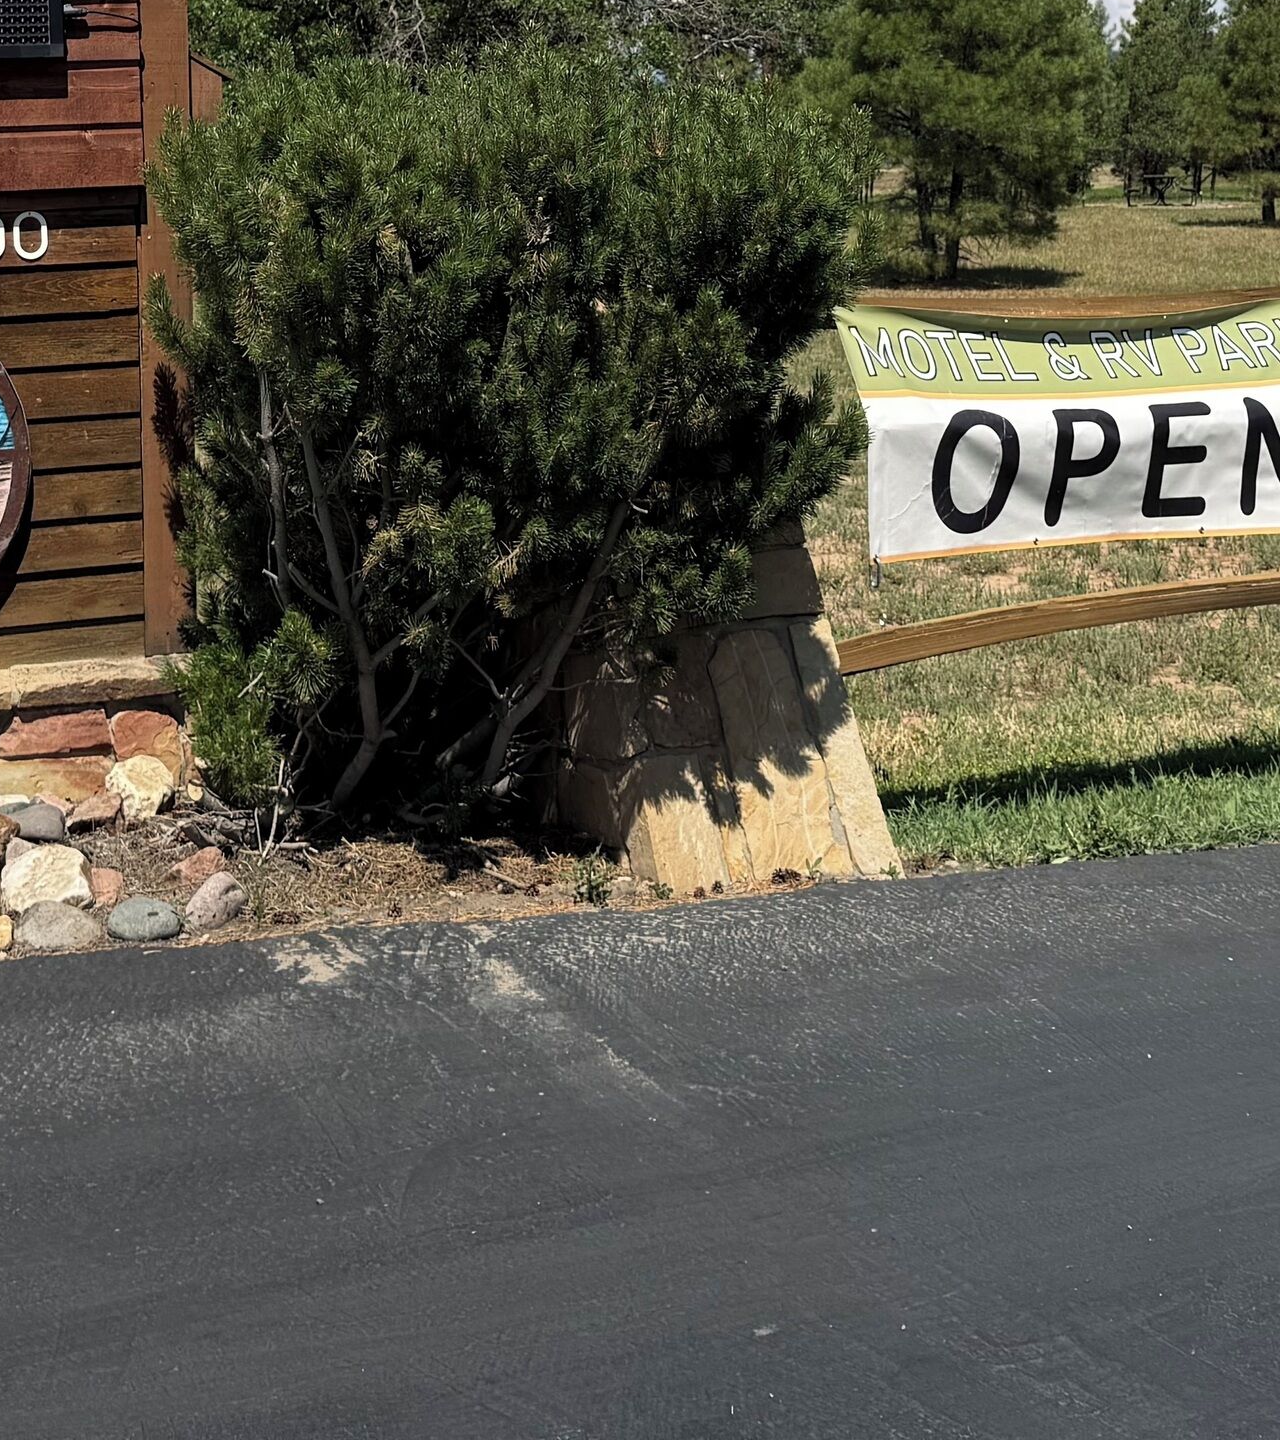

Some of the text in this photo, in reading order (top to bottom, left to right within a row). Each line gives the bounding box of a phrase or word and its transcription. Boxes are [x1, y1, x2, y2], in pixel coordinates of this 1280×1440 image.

[849, 326, 1039, 381] MOTEL
[1042, 331, 1092, 380] &
[1091, 328, 1162, 379] RV
